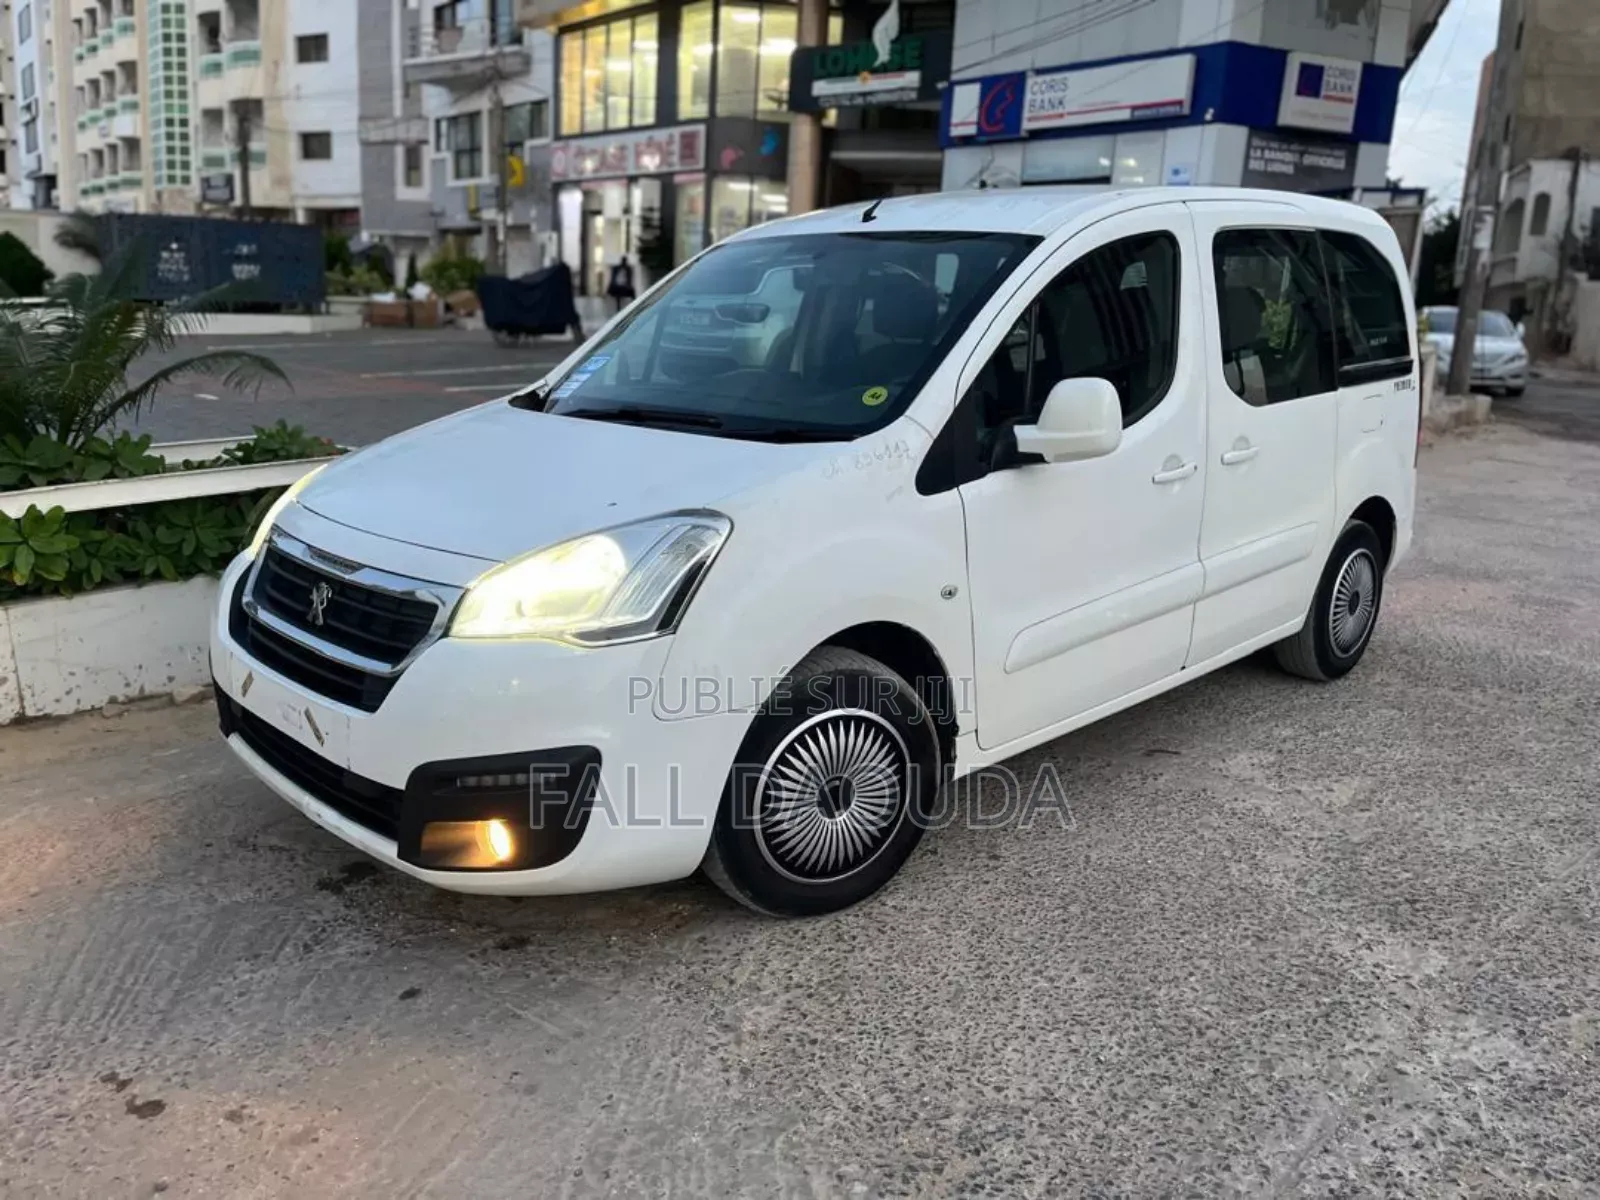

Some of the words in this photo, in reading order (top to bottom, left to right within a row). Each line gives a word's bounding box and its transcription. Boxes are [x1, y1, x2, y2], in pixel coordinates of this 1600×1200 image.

[1030, 77, 1069, 96] CORIS
[1324, 79, 1353, 93] BANK
[1028, 96, 1067, 113] BANK
